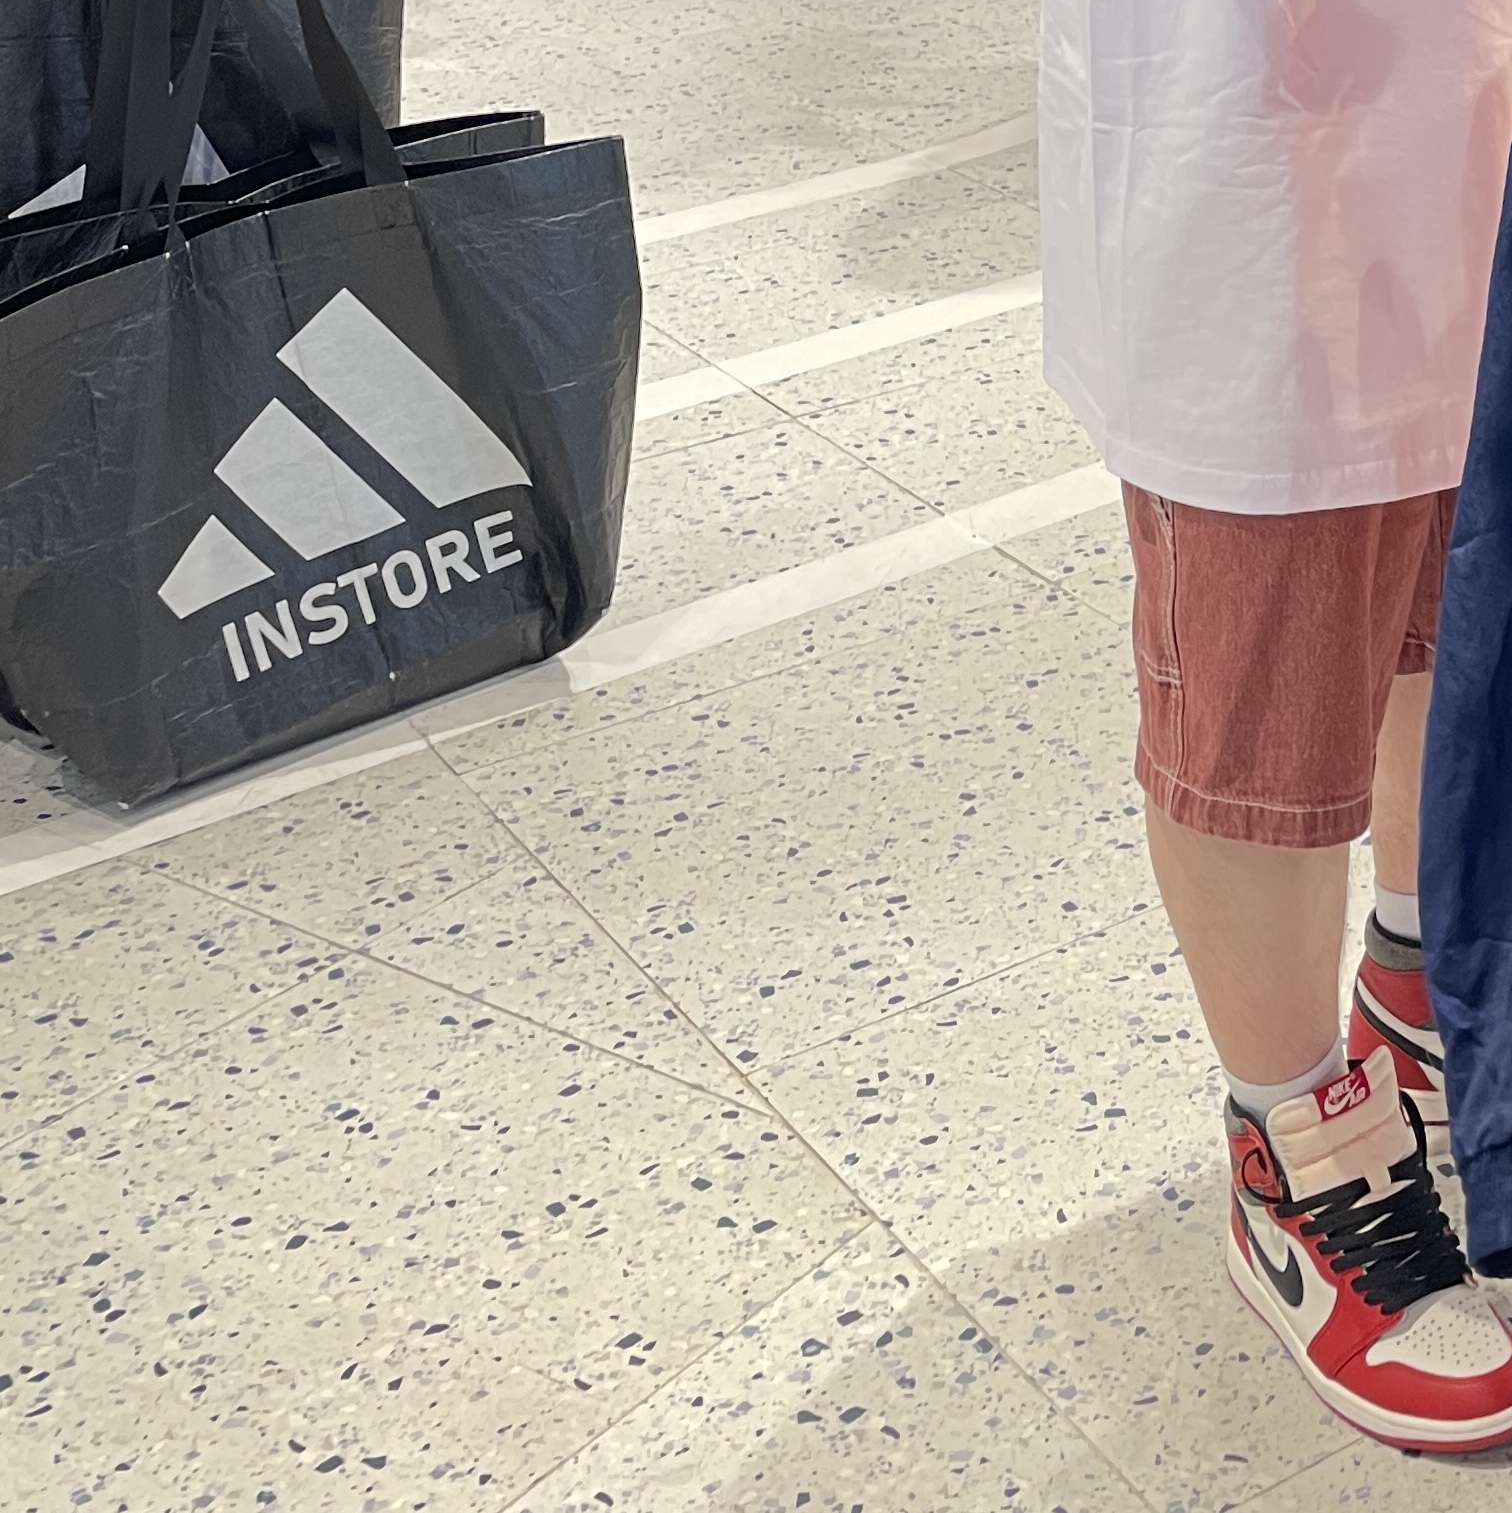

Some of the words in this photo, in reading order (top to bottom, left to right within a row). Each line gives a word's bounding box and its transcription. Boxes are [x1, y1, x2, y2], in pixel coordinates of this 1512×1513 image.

[221, 510, 523, 682] INSTORE
[1328, 1076, 1351, 1102] NIKE
[1348, 1087, 1366, 1108] AIR
